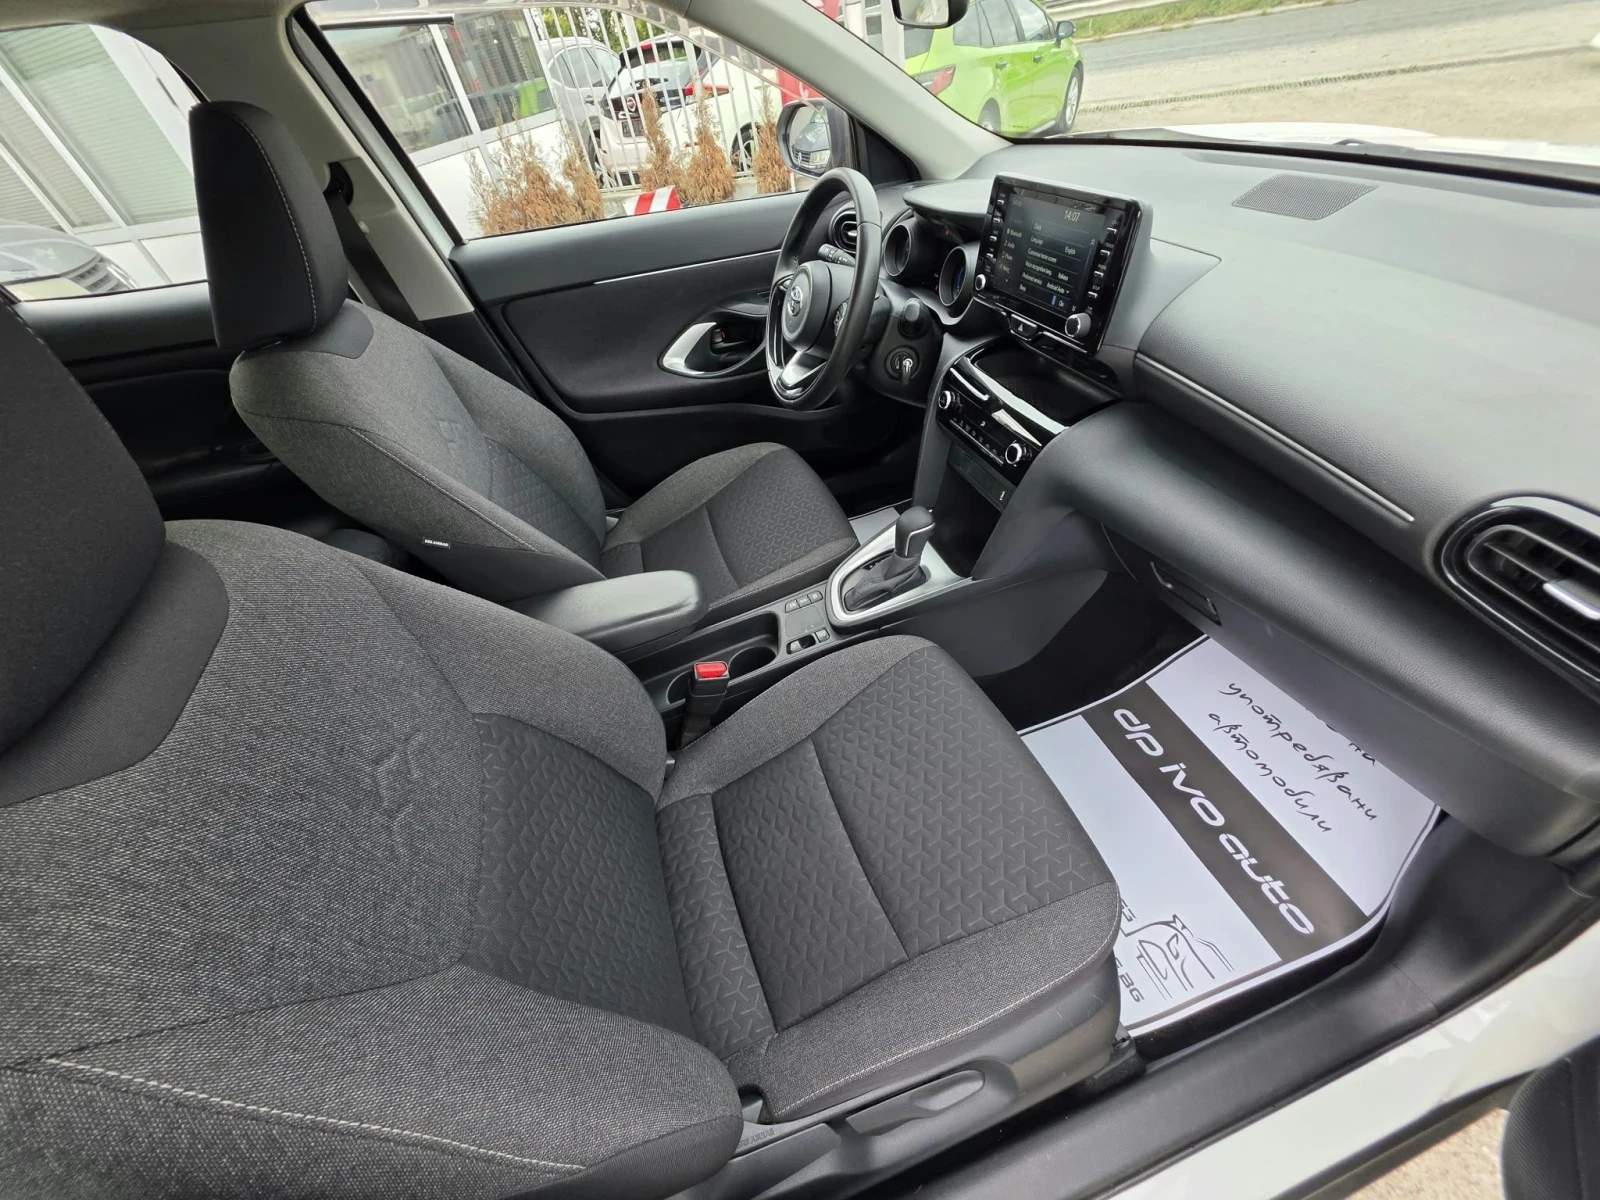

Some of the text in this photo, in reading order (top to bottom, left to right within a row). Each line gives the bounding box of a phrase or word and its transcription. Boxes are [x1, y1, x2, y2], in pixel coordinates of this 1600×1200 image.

[1030, 236, 1044, 245] Language
[1064, 209, 1080, 222] 14:07
[1064, 245, 1076, 255] English
[1208, 712, 1332, 833] автомобили
[1217, 682, 1378, 821] употребявани
[1113, 708, 1315, 934] dp ivo auto
